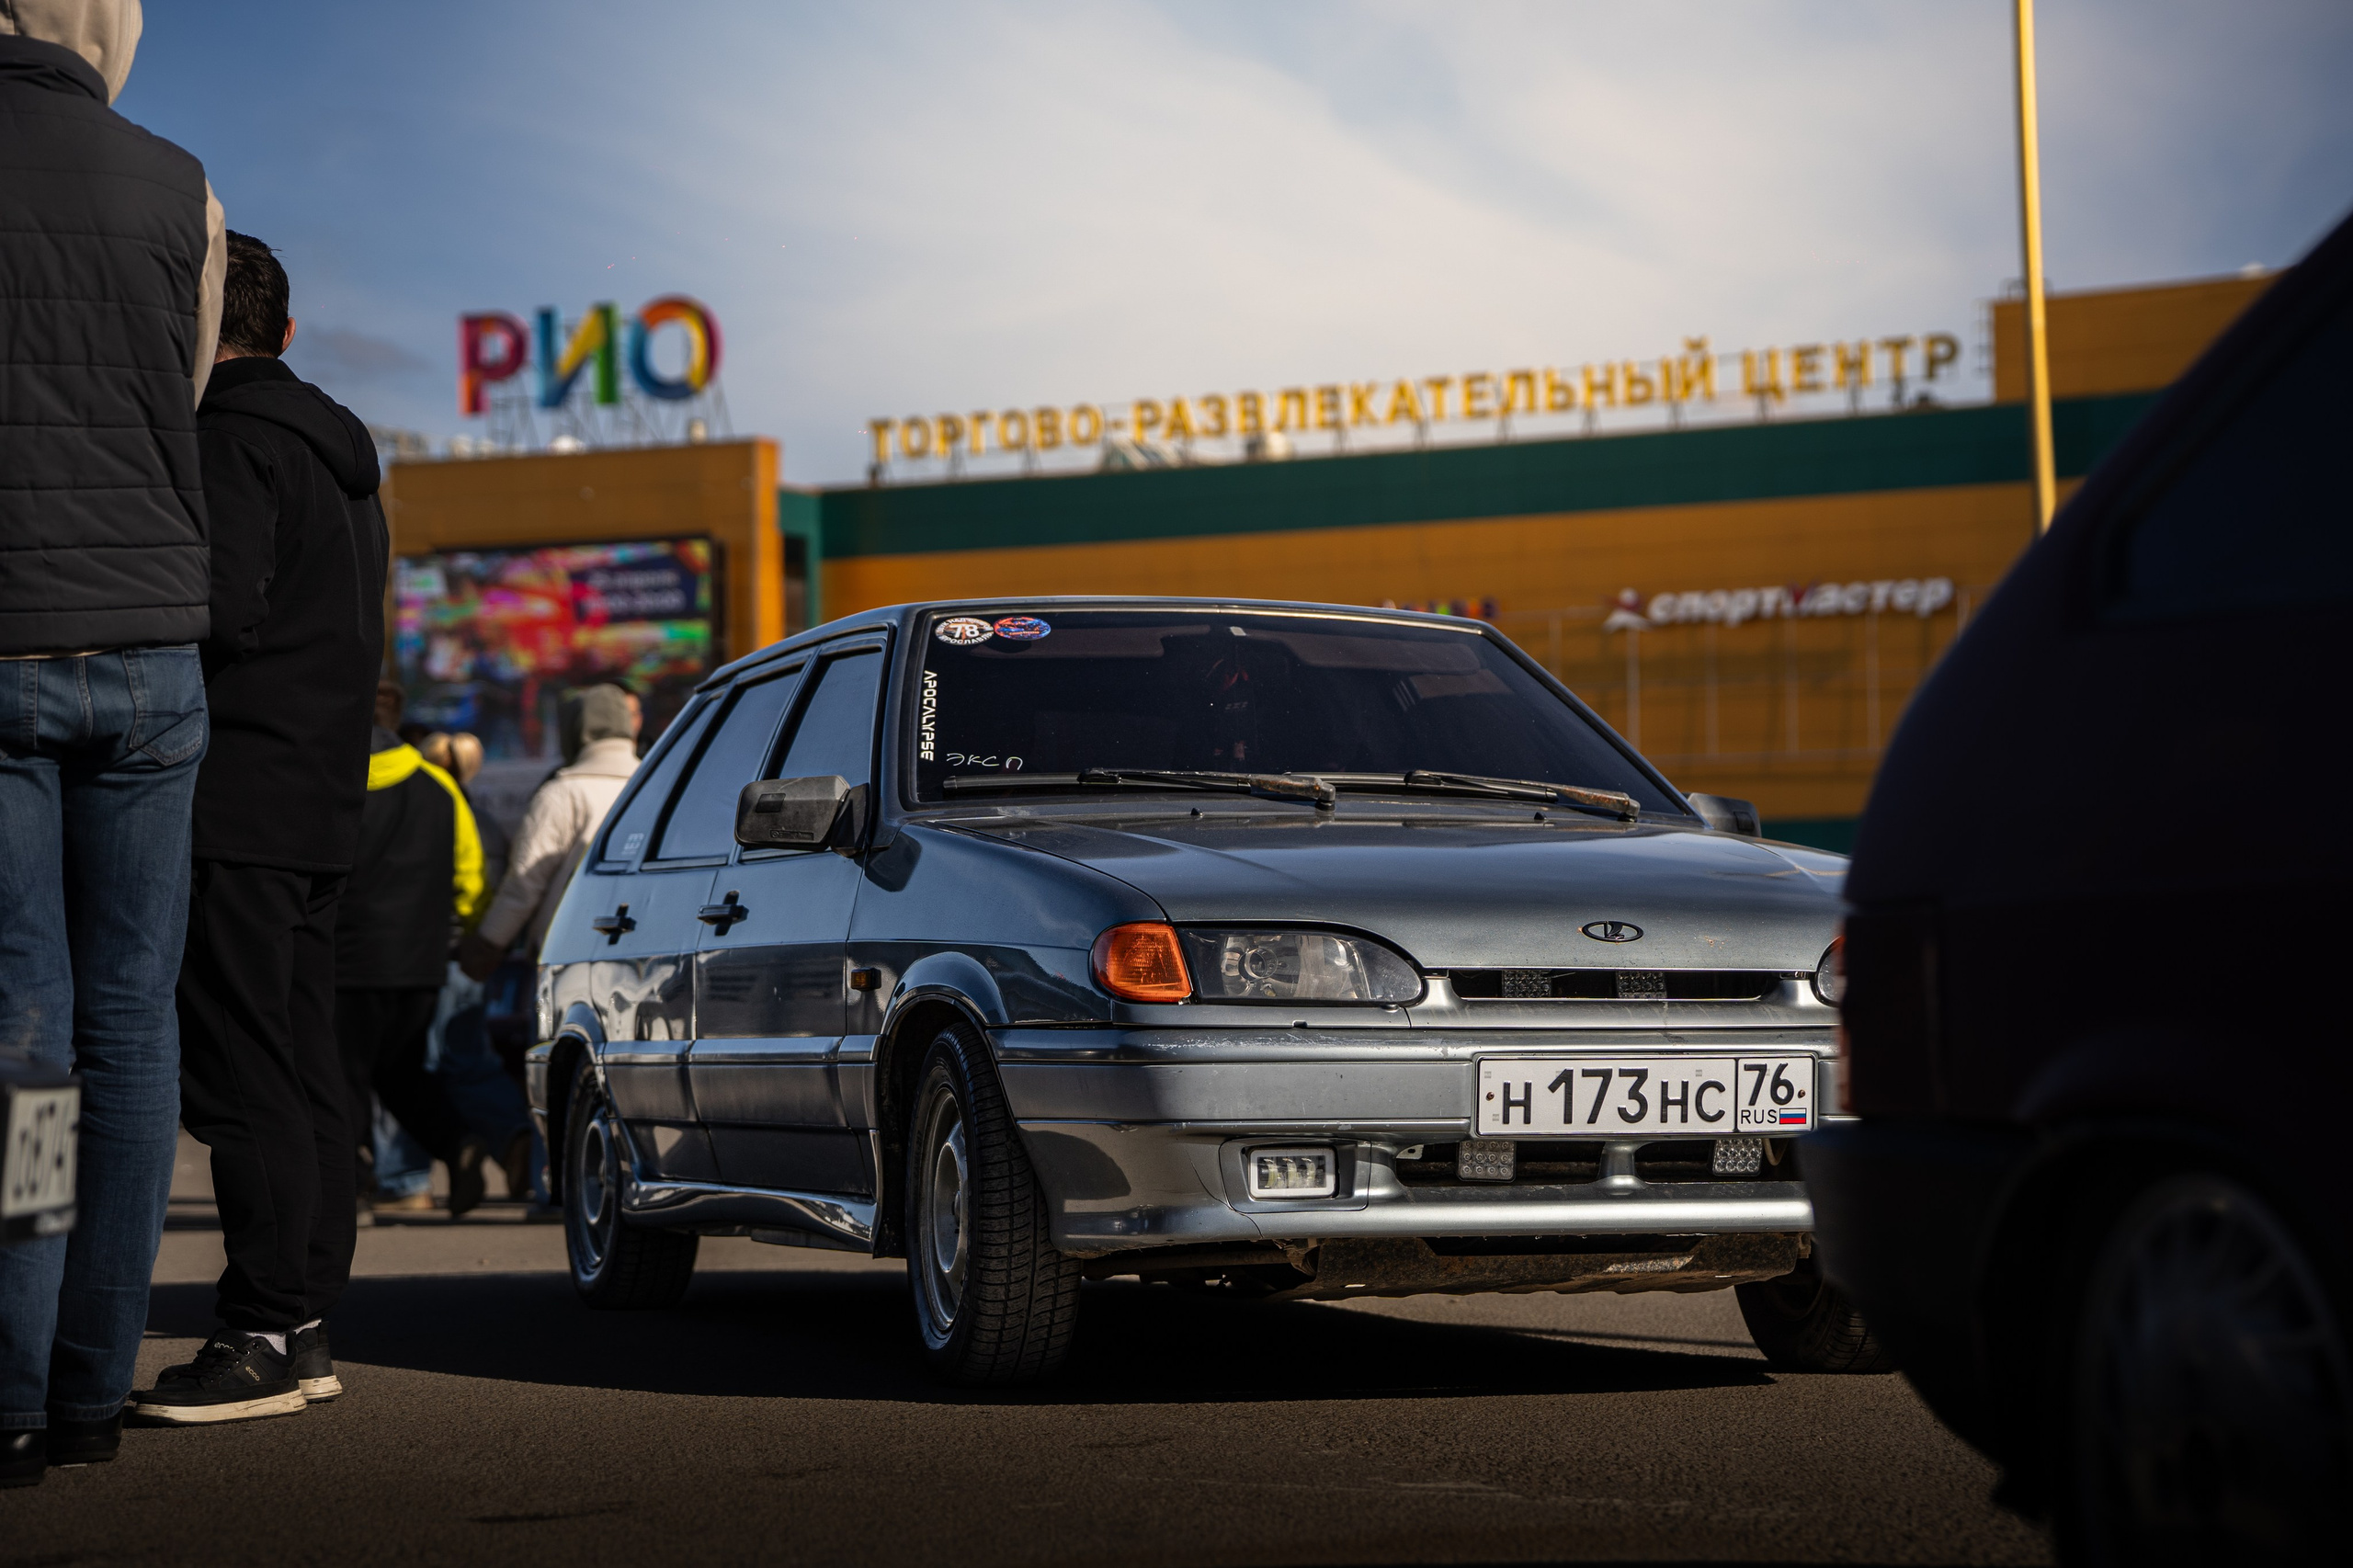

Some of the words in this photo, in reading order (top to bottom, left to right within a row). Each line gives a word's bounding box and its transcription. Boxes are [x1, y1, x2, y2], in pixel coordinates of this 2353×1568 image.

[457, 294, 724, 416] РИО
[869, 336, 1717, 462] ТОРГОВО-РАЗВЛЕКАТЕЛЬНЫЙ
[1740, 332, 1961, 402] ЦЕНТР
[949, 624, 980, 638] 78
[921, 670, 938, 761] APOCALYPSE
[1743, 1062, 1795, 1107] 76
[1741, 1108, 1778, 1125] RUS
[245, 1366, 260, 1381] ecco
